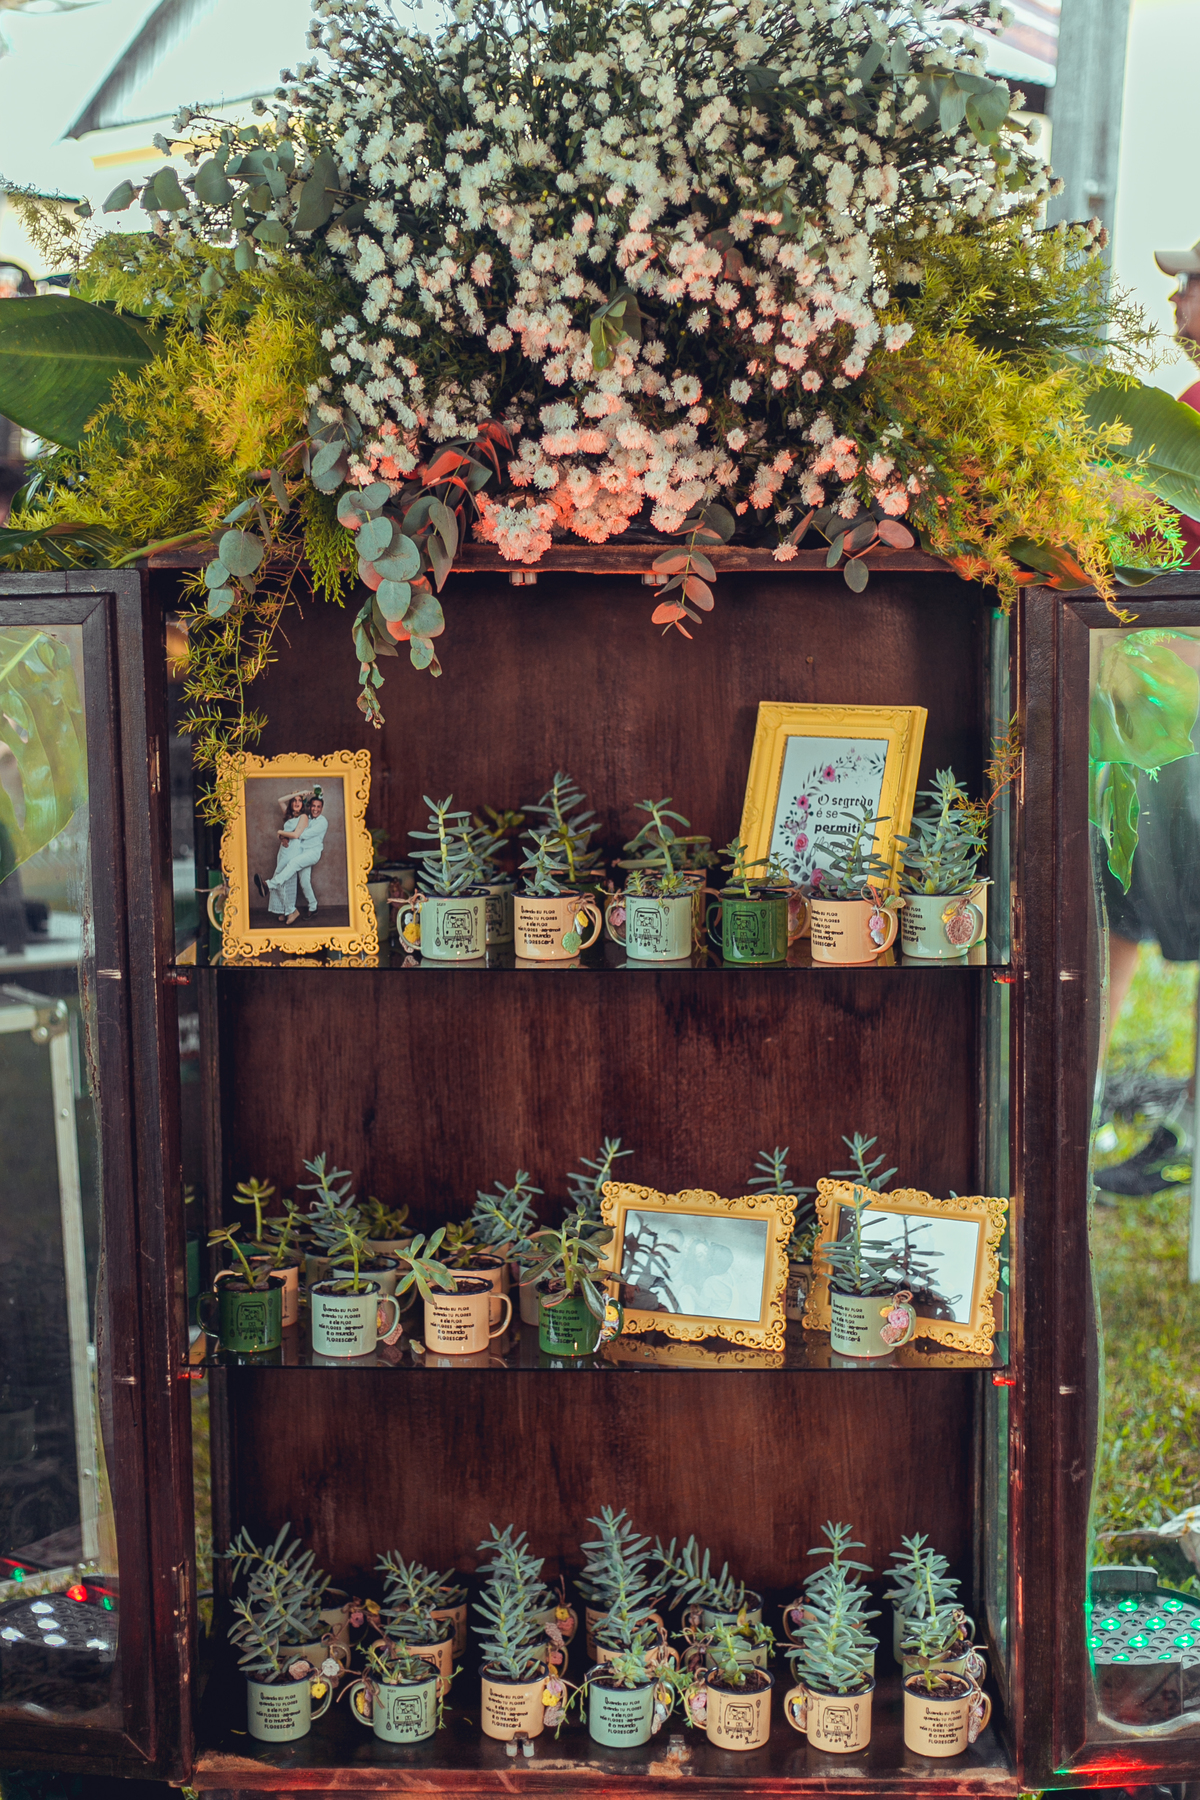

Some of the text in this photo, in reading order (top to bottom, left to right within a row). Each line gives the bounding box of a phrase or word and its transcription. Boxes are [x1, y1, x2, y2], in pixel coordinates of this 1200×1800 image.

[818, 794, 874, 809] O segredo
[816, 808, 838, 819] é se
[814, 823, 866, 834] permiti
